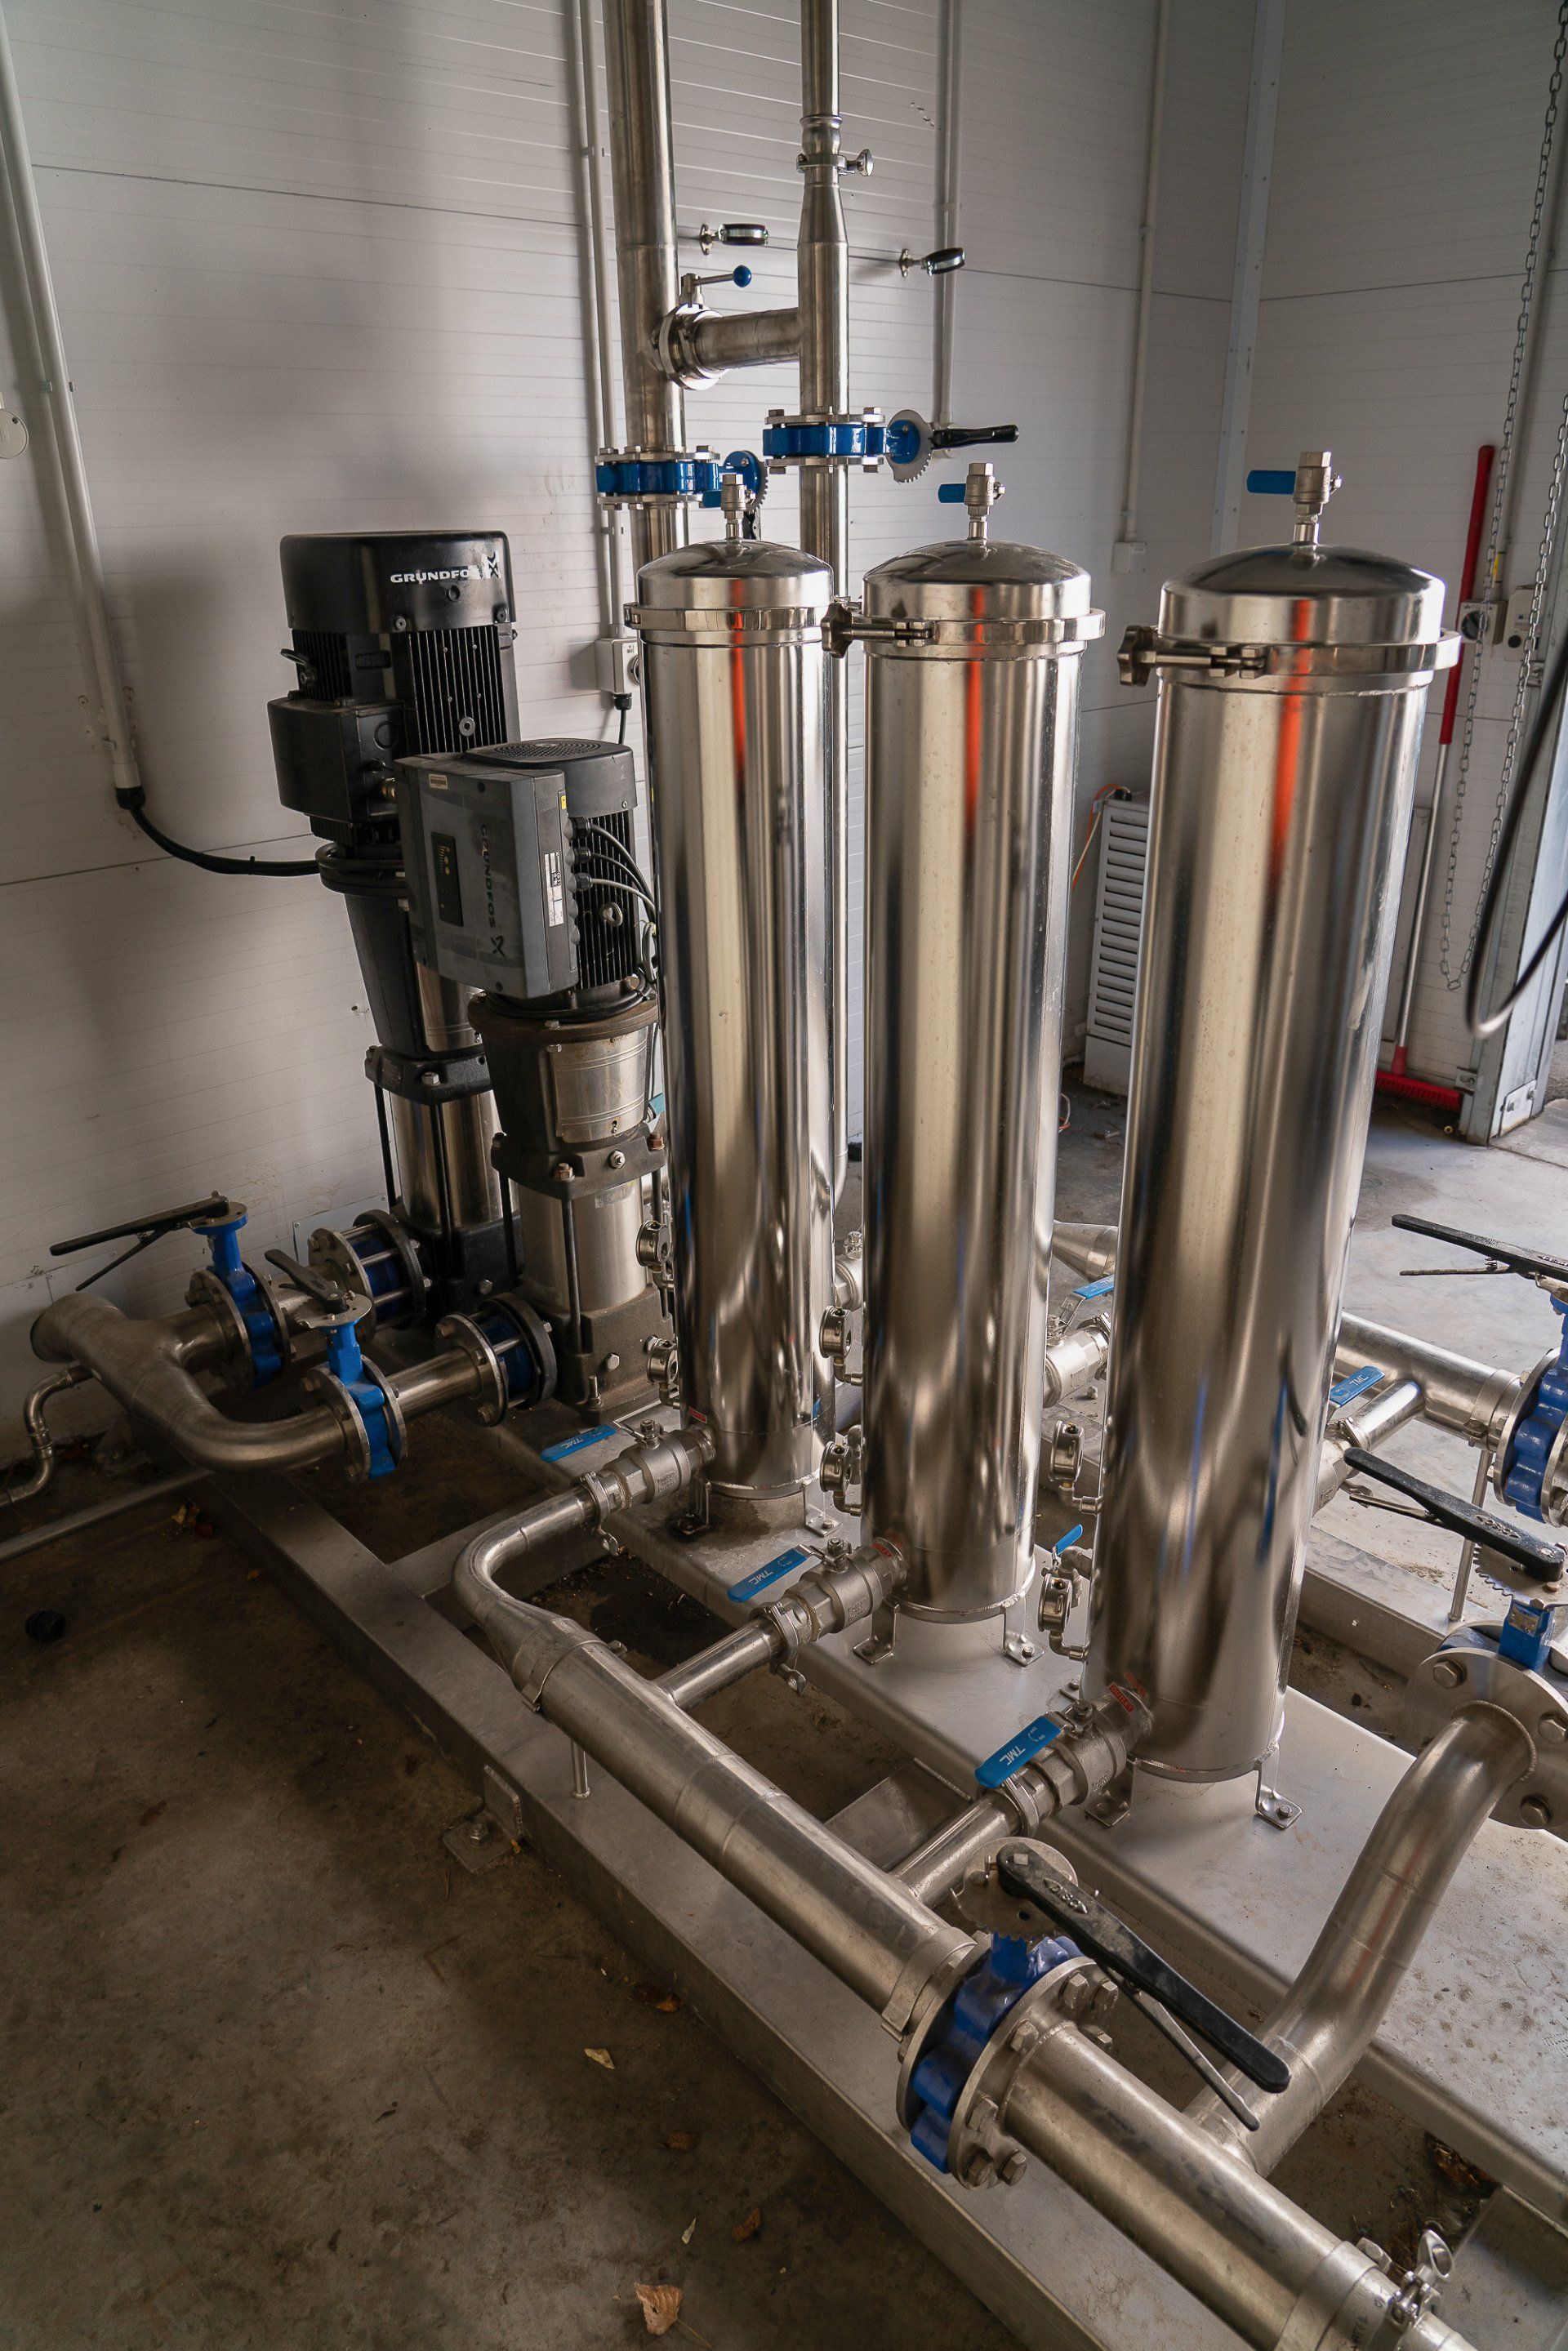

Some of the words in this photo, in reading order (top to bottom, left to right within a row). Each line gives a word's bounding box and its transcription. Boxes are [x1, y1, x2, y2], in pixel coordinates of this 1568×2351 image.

[390, 568, 479, 583] GRUNDFO
[748, 1570, 773, 1585] TMC
[999, 1746, 1026, 1765] TMC
